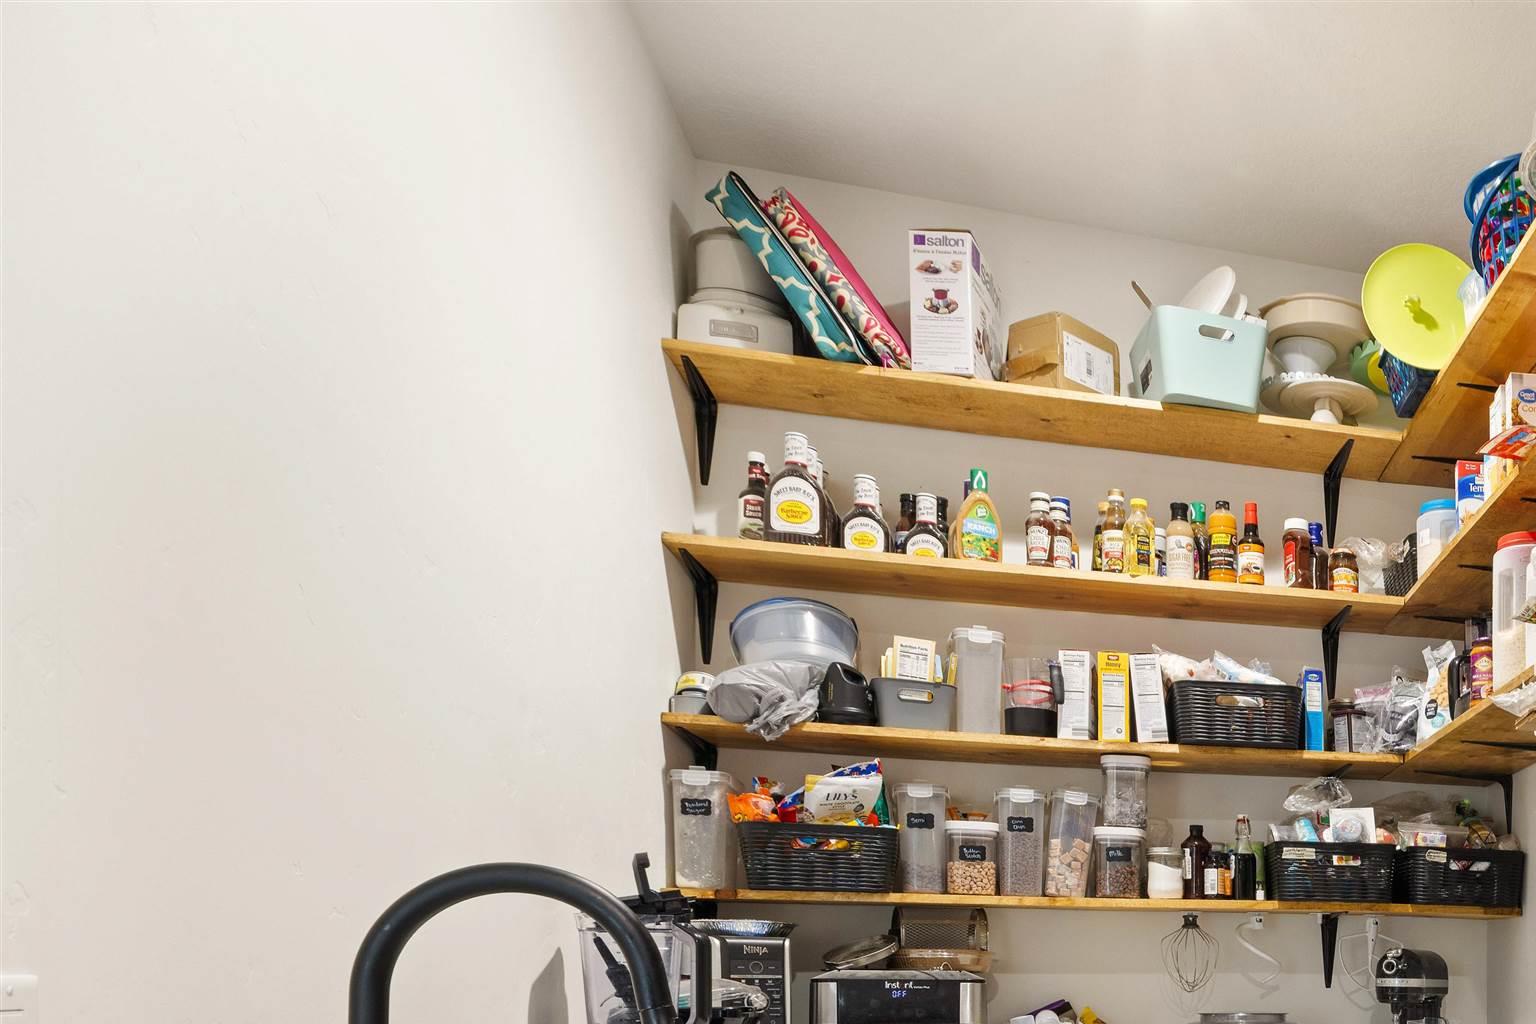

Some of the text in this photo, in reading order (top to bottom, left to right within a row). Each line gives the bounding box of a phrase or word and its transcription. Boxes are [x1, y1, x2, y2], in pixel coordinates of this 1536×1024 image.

[926, 234, 965, 248] salton
[968, 522, 996, 534] RANCH
[743, 944, 769, 956] NINJA
[891, 990, 908, 998] OFF
